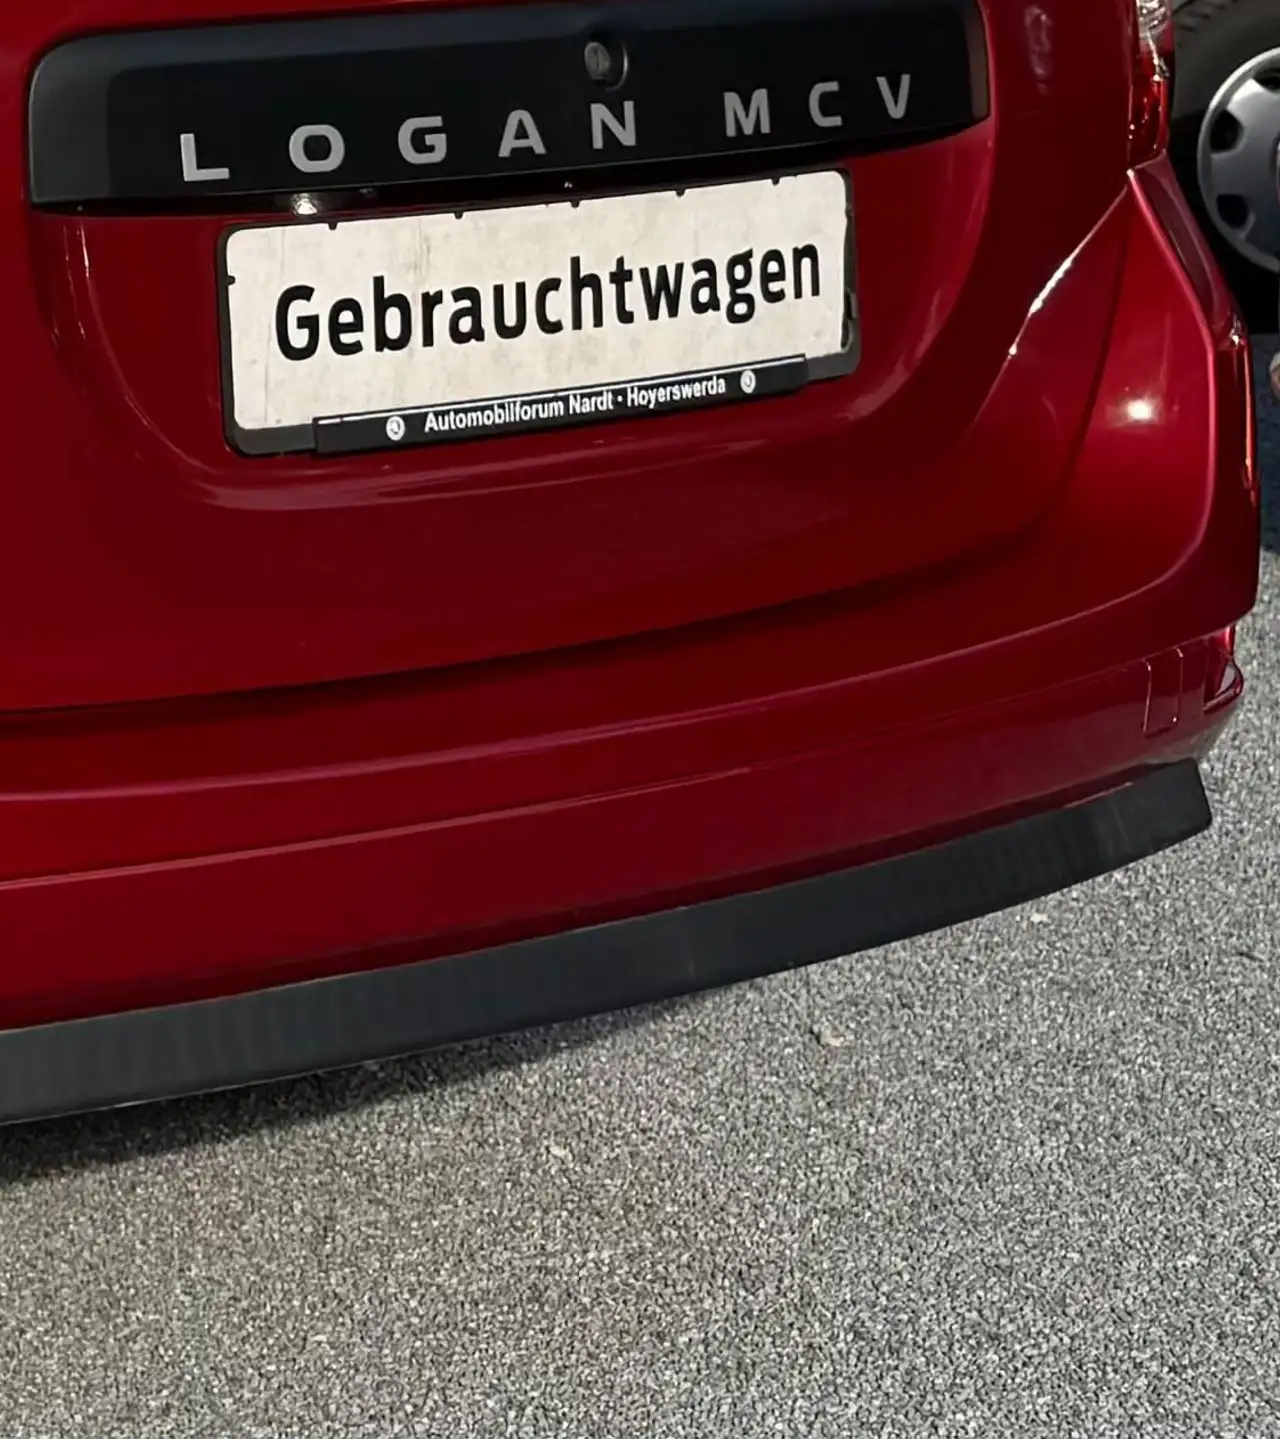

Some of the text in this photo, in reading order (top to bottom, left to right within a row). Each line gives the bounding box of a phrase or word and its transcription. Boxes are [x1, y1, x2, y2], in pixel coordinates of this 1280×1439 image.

[178, 73, 912, 183] LOGAN MCV
[274, 242, 821, 362] Gebrauchtwagen
[424, 375, 726, 433] Automobilforum Nardt Hoyerswerda
